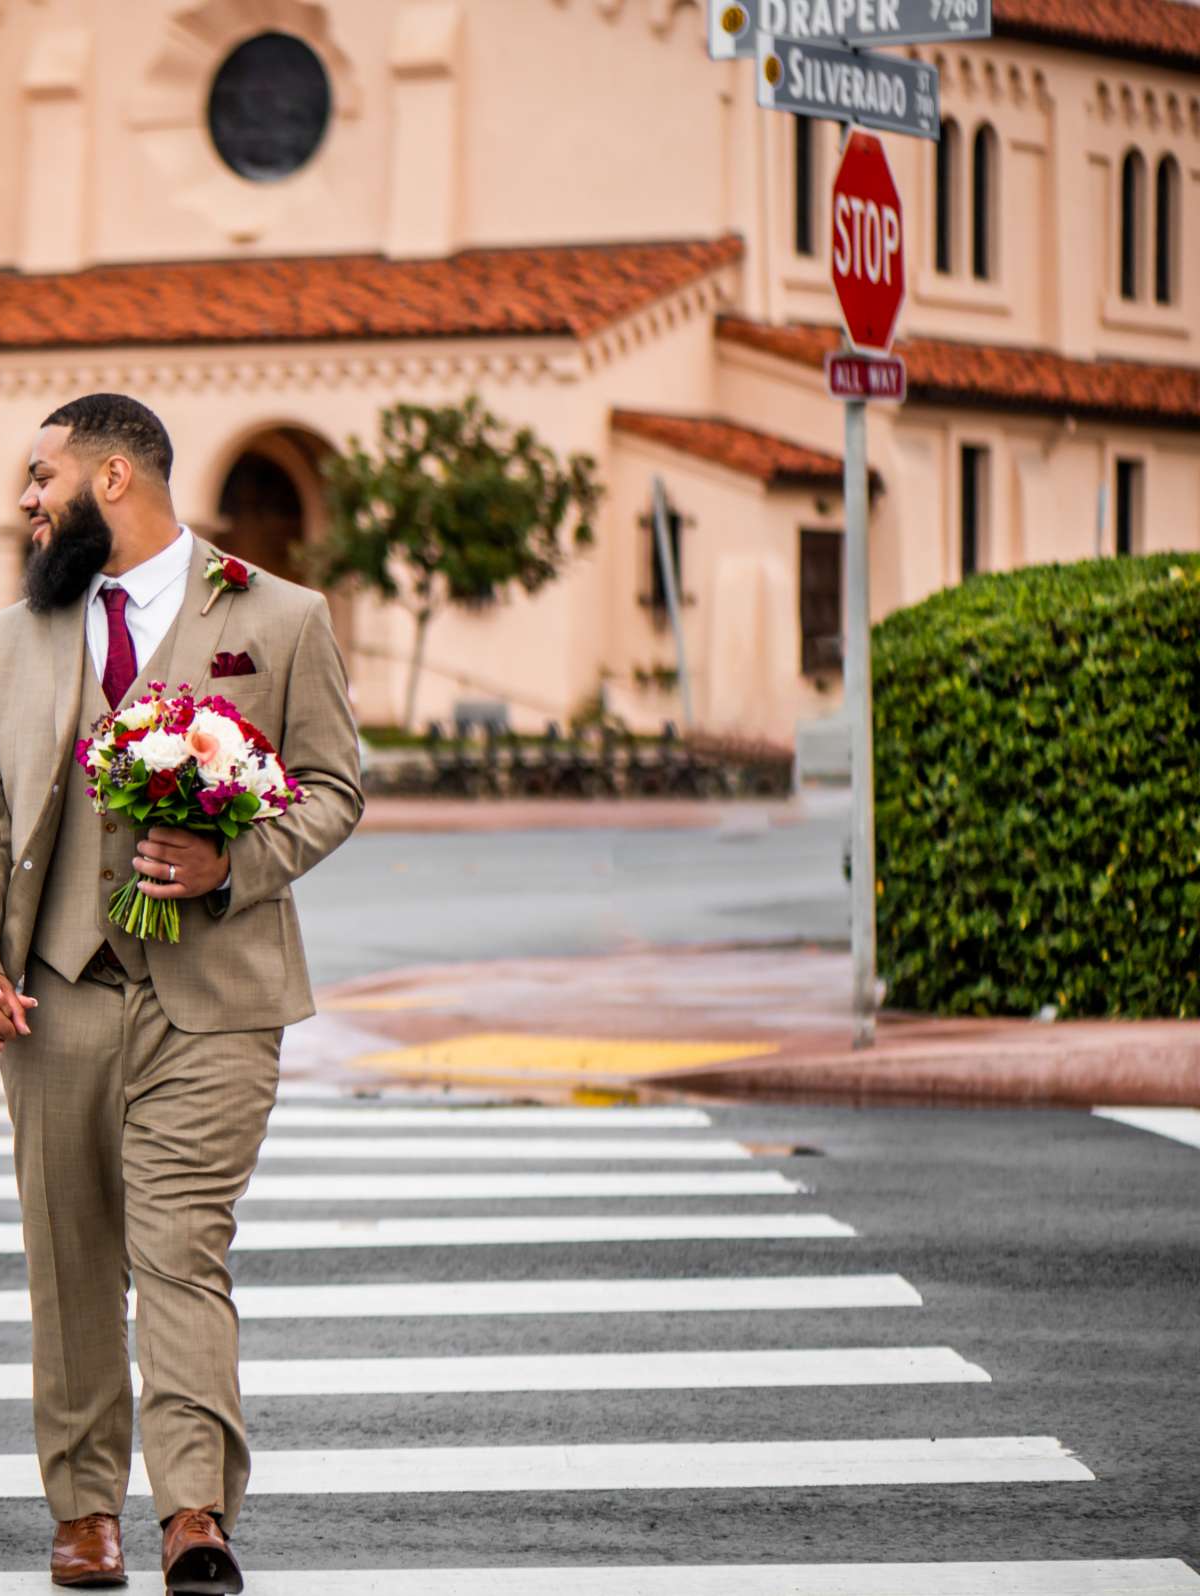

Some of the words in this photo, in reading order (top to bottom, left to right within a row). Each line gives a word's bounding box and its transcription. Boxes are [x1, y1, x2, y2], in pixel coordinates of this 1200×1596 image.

[759, 0, 900, 38] DRAPER
[788, 48, 907, 118] SILVERADO
[833, 193, 900, 286] STOP
[834, 362, 862, 392] ALL
[867, 364, 899, 392] WAY
